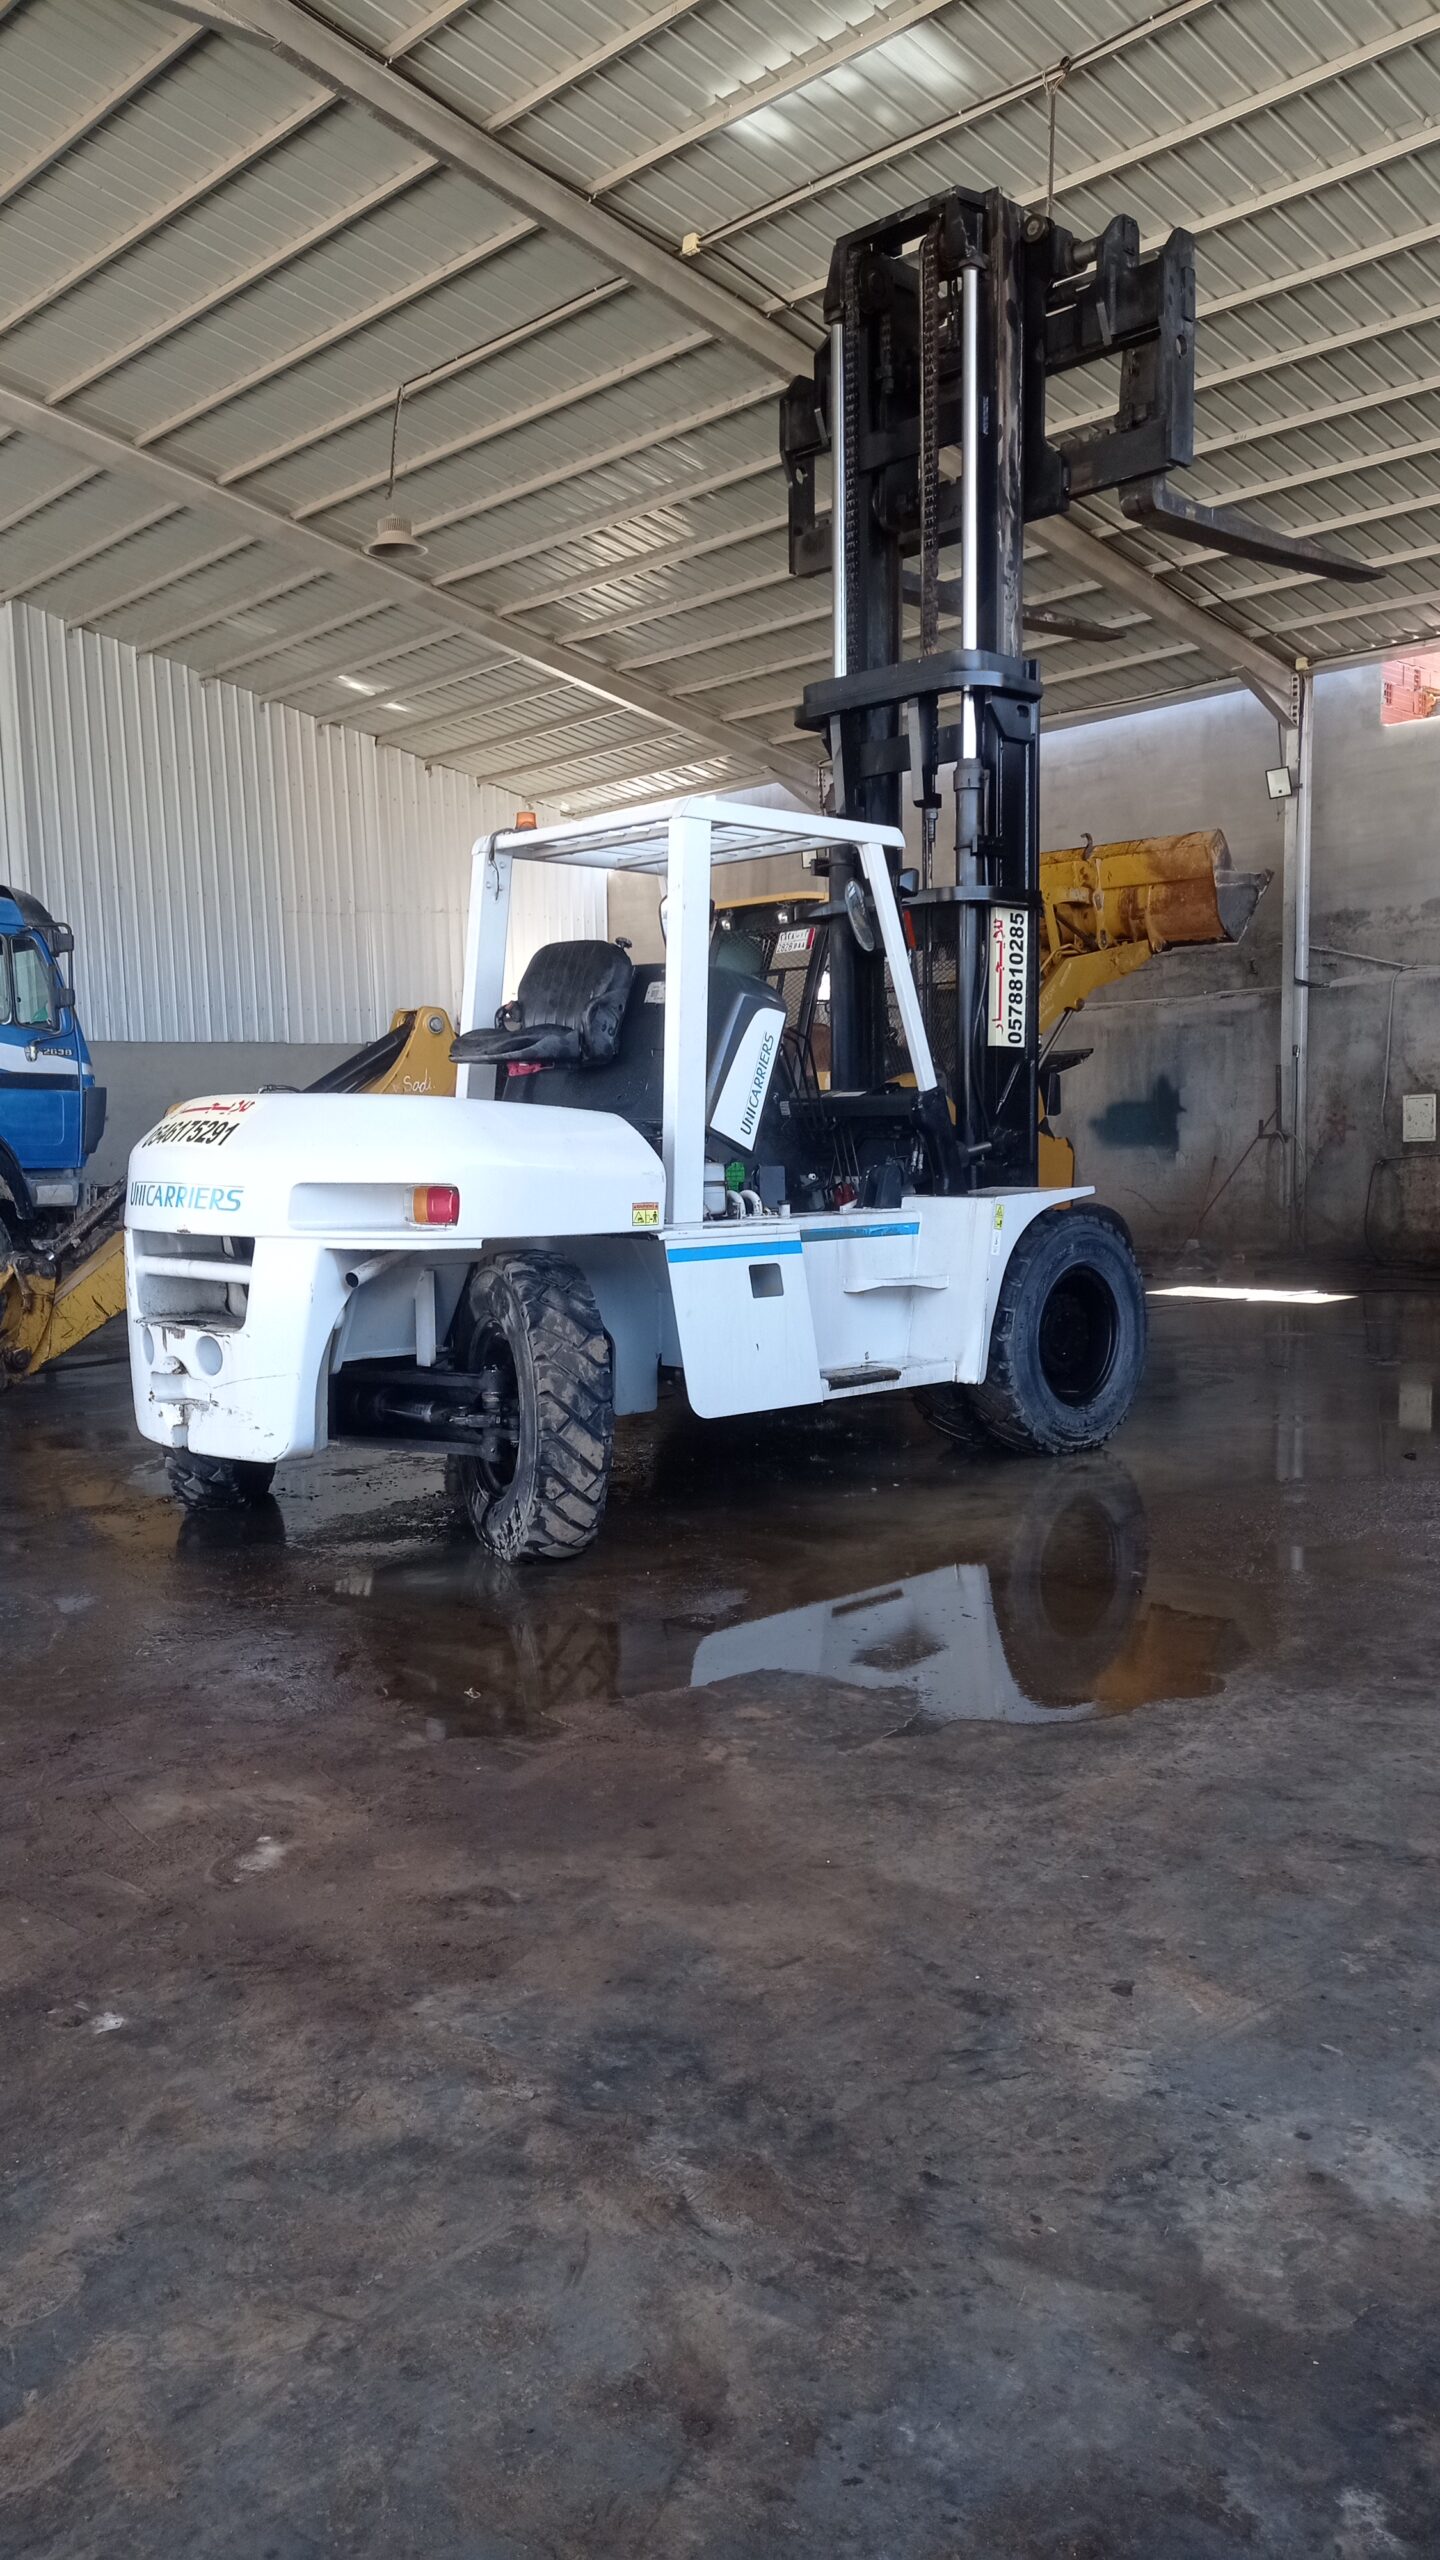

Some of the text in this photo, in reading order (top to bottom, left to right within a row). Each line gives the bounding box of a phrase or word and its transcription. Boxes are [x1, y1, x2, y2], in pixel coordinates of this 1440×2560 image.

[1008, 912, 1025, 1044] 0578810285
[740, 1031, 774, 1136] UNICARRIERS
[130, 1181, 245, 1212] UNICARRIERS
